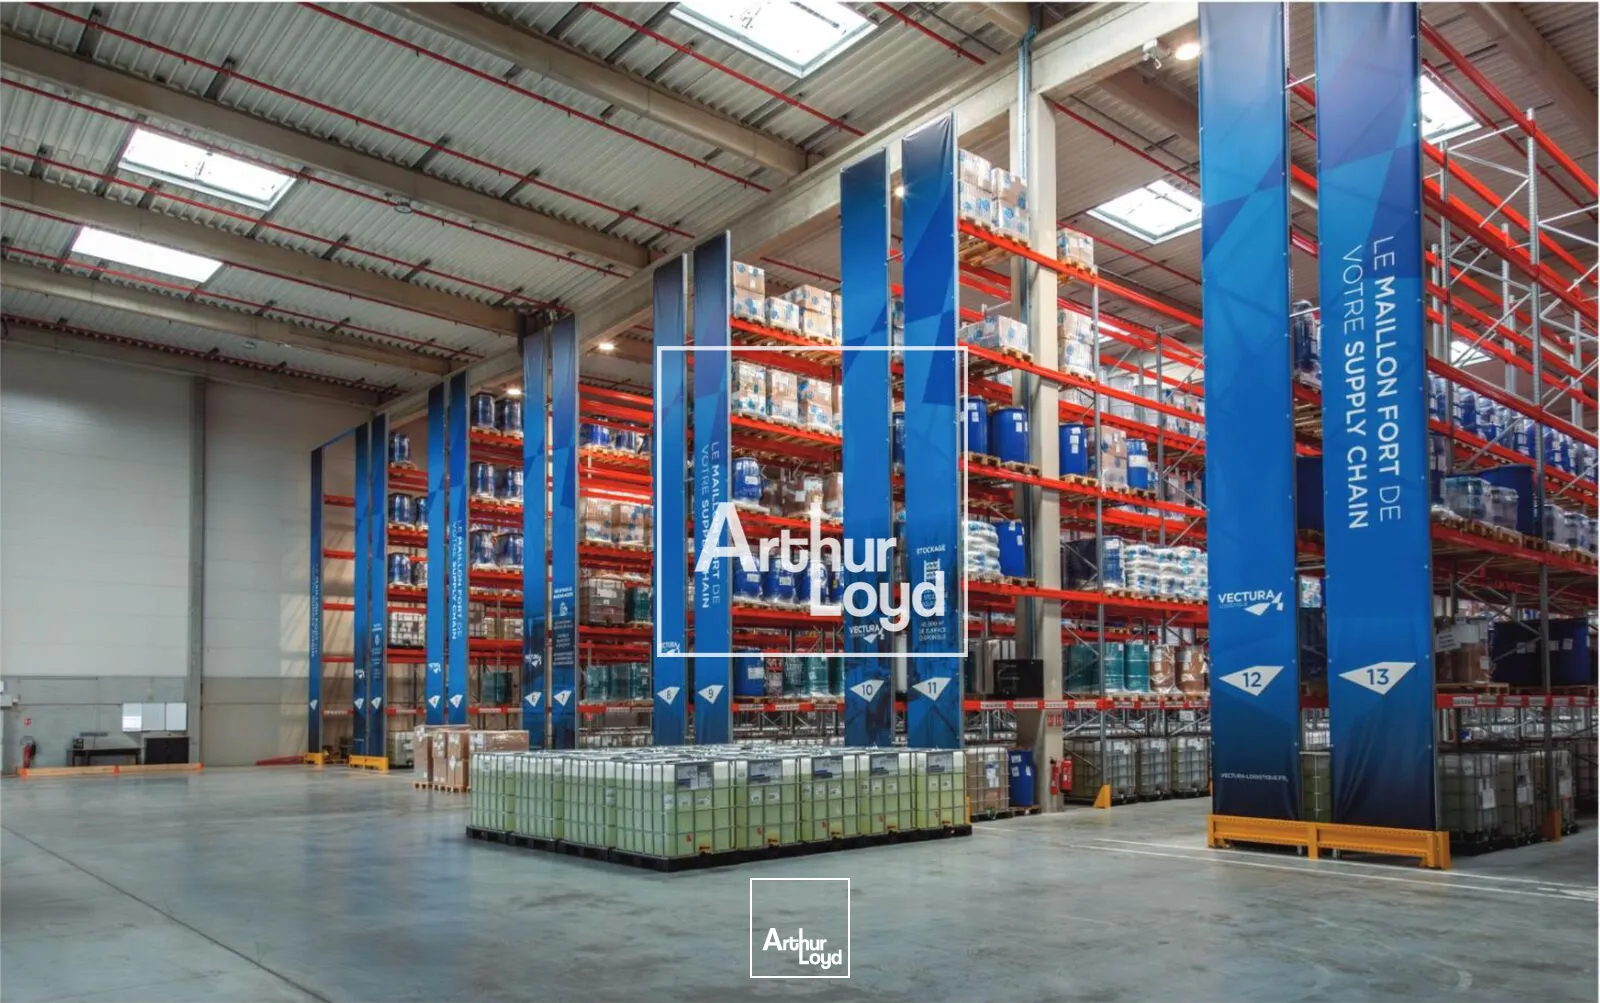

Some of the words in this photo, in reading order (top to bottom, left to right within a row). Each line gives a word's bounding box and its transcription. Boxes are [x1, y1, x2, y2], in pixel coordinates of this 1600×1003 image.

[1373, 235, 1395, 271] LE
[1342, 244, 1365, 335] VOTRE
[1374, 275, 1398, 397] MAILLON
[1344, 340, 1368, 436] SUPPLY
[711, 441, 720, 460] LE
[1376, 404, 1400, 476] FORT
[701, 444, 710, 496] VOTRE
[1346, 446, 1369, 529] CHAIN
[1379, 485, 1402, 522] DE
[702, 571, 710, 608] HAIN
[1218, 589, 1275, 604] VECTURA
[849, 624, 880, 634] VECTURA
[861, 684, 873, 696] 10
[927, 682, 937, 694] 11
[1242, 672, 1262, 688] 12
[1366, 668, 1389, 685] 13
